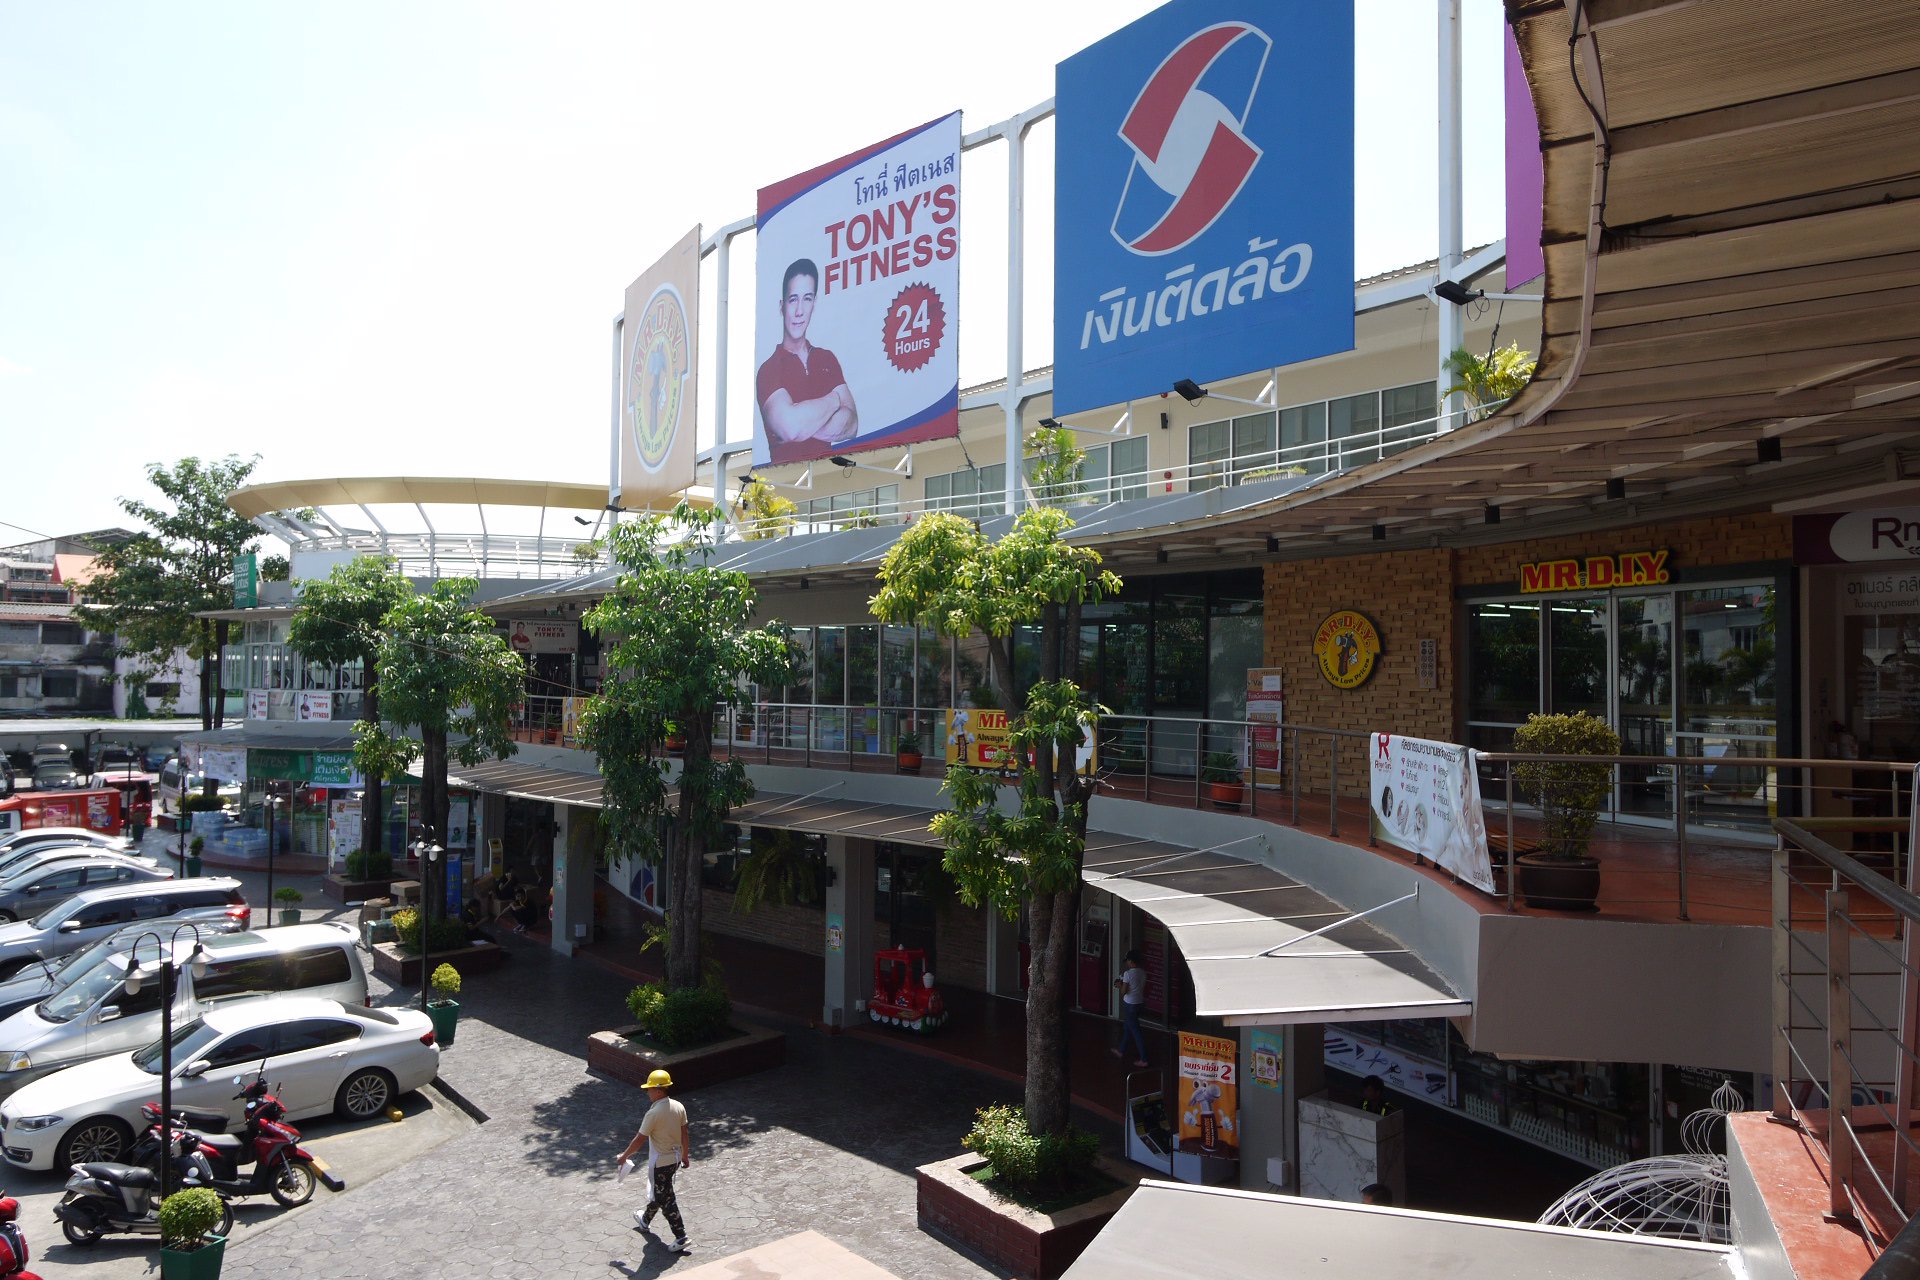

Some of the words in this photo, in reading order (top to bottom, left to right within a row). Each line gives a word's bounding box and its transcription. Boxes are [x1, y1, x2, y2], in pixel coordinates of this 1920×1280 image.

[854, 162, 889, 206] โทนี่
[893, 152, 955, 193] ฟิตเนส
[825, 183, 957, 259] TONY'S
[825, 226, 957, 295] FITNESS
[1080, 236, 1313, 350] เงินติดล้อ
[895, 299, 931, 340] 24
[895, 336, 931, 356] Hours
[1847, 576, 1893, 595] อาเนอร์
[1322, 659, 1339, 682] Always
[1354, 658, 1370, 680] Prices
[313, 701, 328, 709] TONY'S
[977, 733, 1003, 744] Always
[1221, 1064, 1232, 1081] 2
